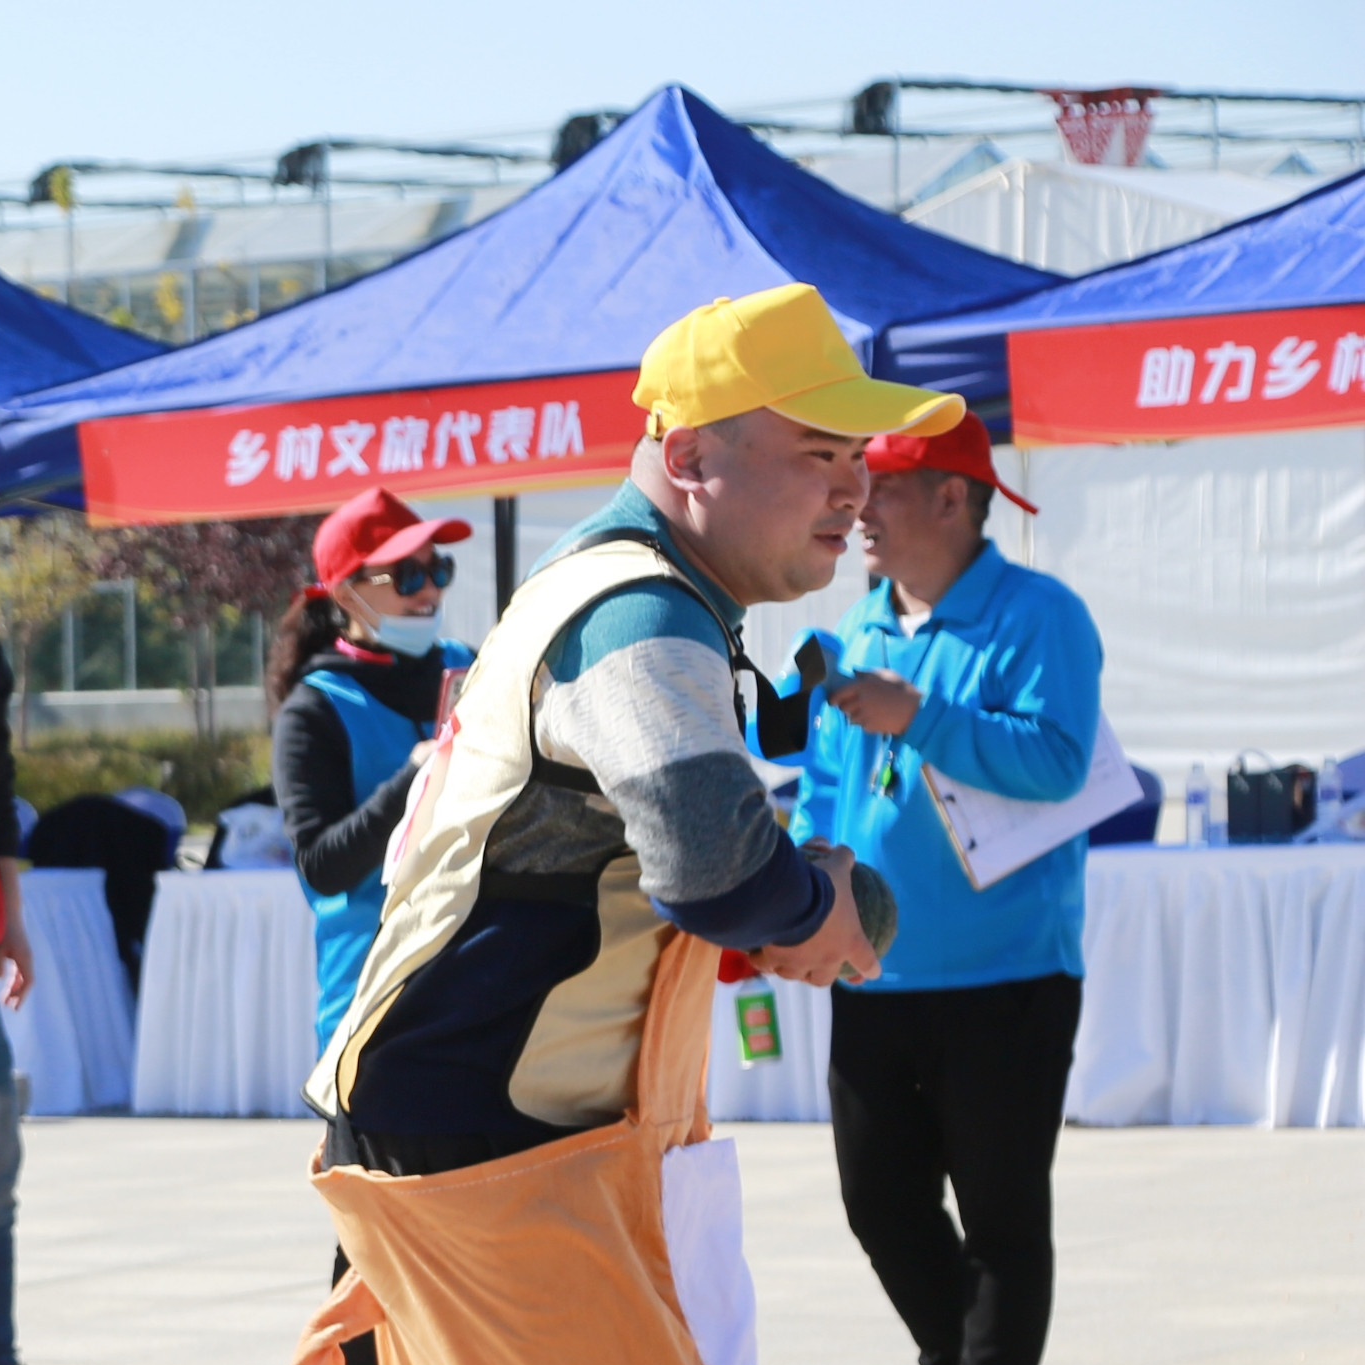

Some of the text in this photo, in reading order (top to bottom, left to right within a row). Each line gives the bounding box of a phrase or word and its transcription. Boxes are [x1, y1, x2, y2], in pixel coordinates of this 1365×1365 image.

[224, 400, 587, 487] 乡村文旅代表队
